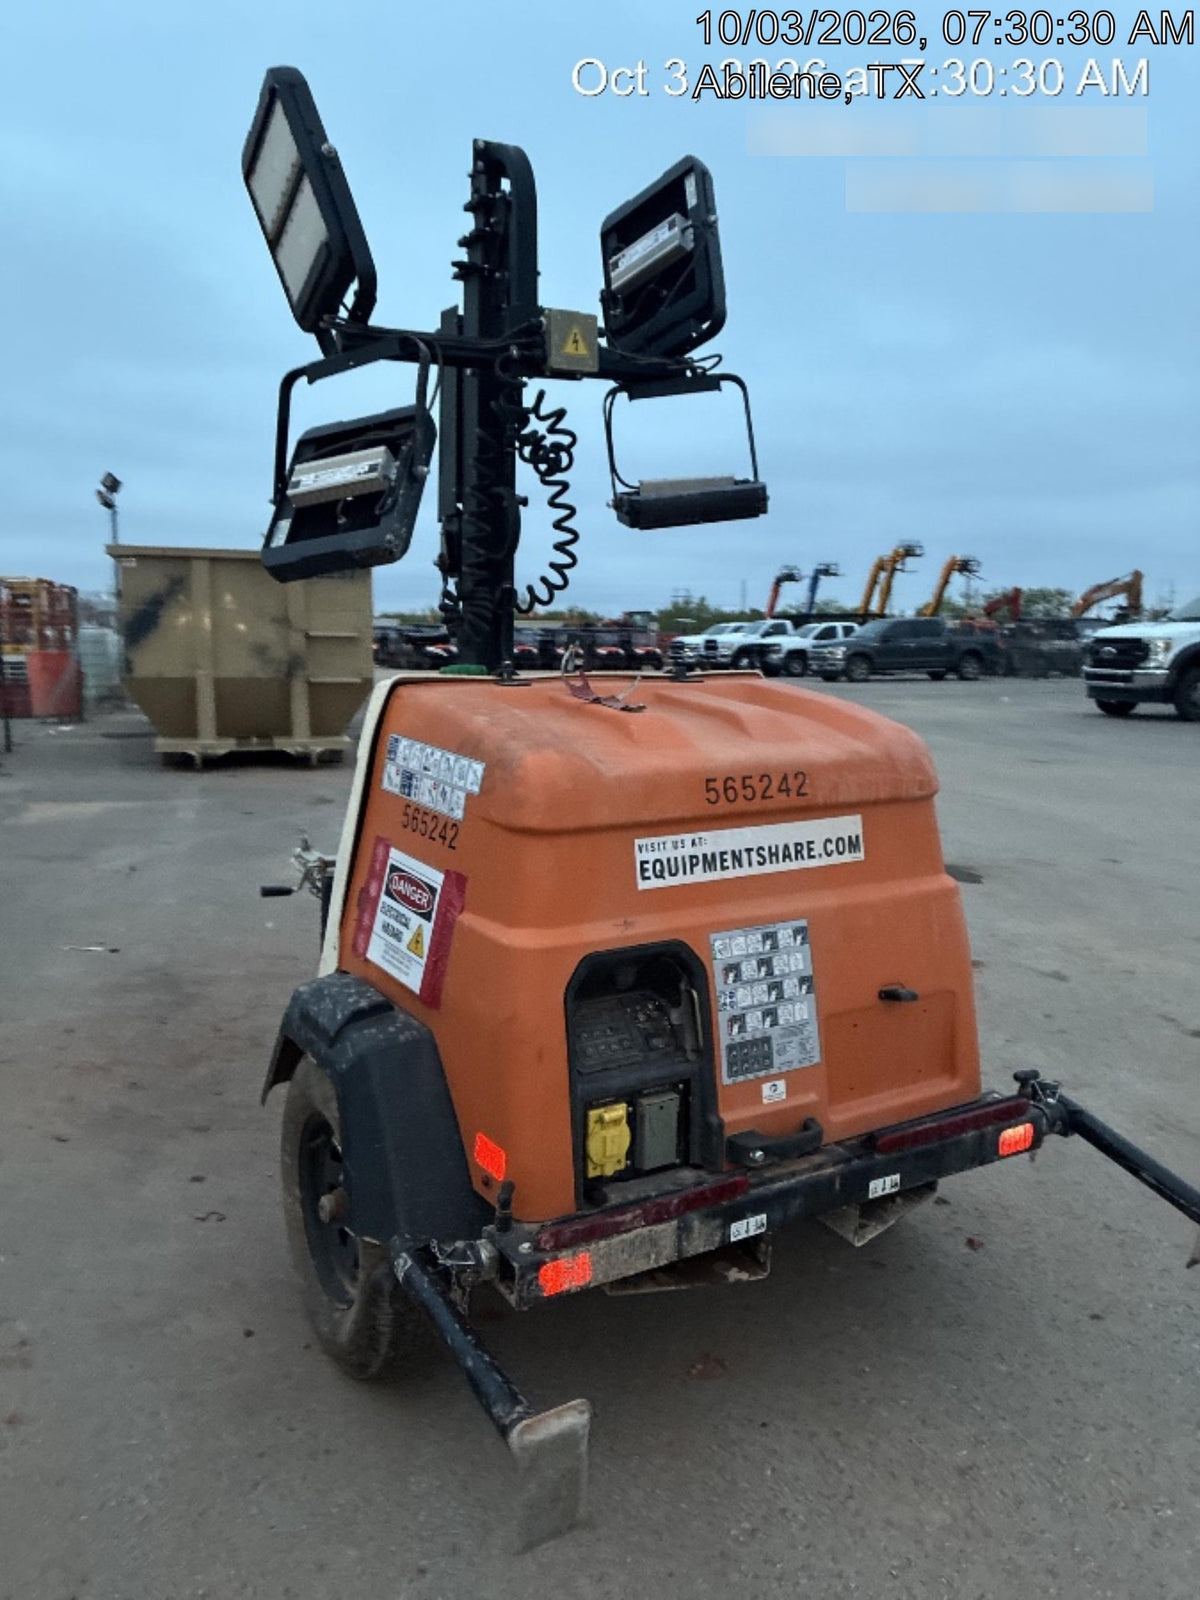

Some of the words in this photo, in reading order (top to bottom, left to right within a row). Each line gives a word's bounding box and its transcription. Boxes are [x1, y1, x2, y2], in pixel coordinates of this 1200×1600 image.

[704, 770, 809, 805] 565242
[401, 803, 460, 851] 565242
[637, 840, 667, 854] VISIT
[671, 837, 686, 850] US
[690, 836, 709, 848] AT:
[638, 833, 863, 882] EQUIPMENTSHARE.COM
[391, 875, 430, 909] DANGER
